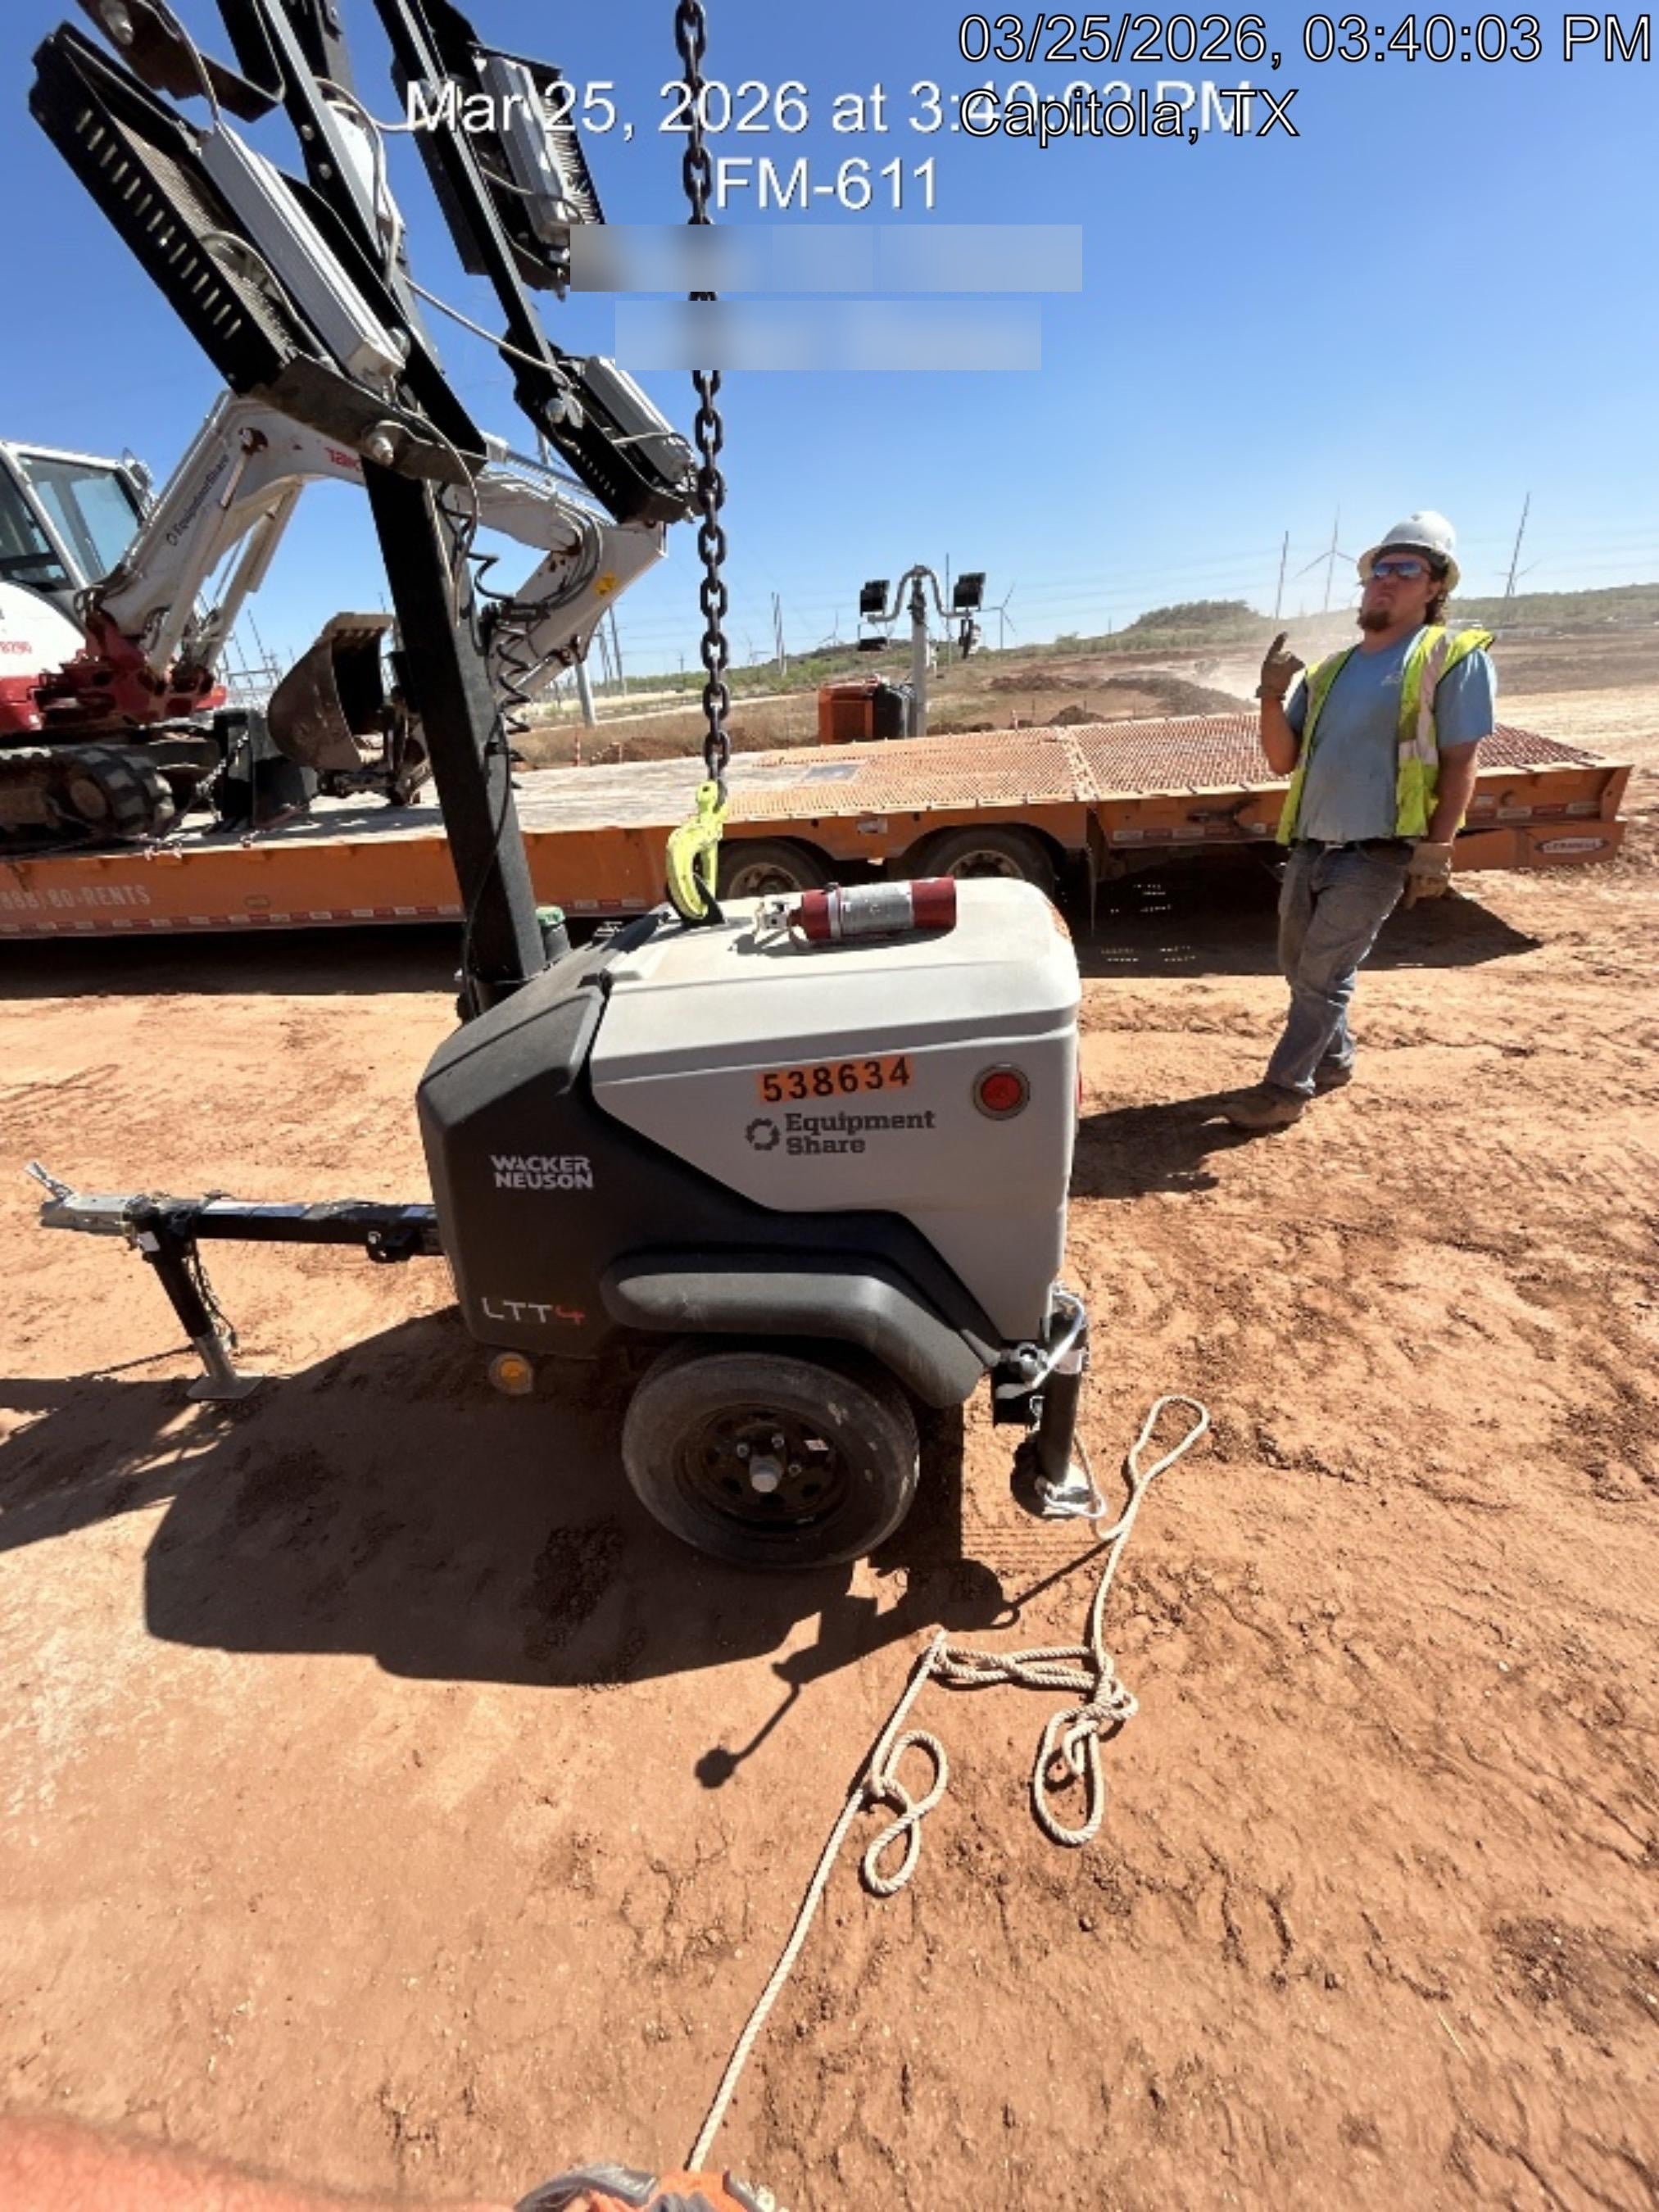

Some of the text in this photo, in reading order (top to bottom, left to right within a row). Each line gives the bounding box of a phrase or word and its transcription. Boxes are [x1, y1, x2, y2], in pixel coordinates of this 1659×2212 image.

[763, 1055, 910, 1103] 538634
[785, 1110, 936, 1136] Equipment
[785, 1135, 866, 1156] Share
[490, 1154, 592, 1172] WACKER
[494, 1172, 594, 1190] NEUSON
[480, 1296, 587, 1326] LTT4
